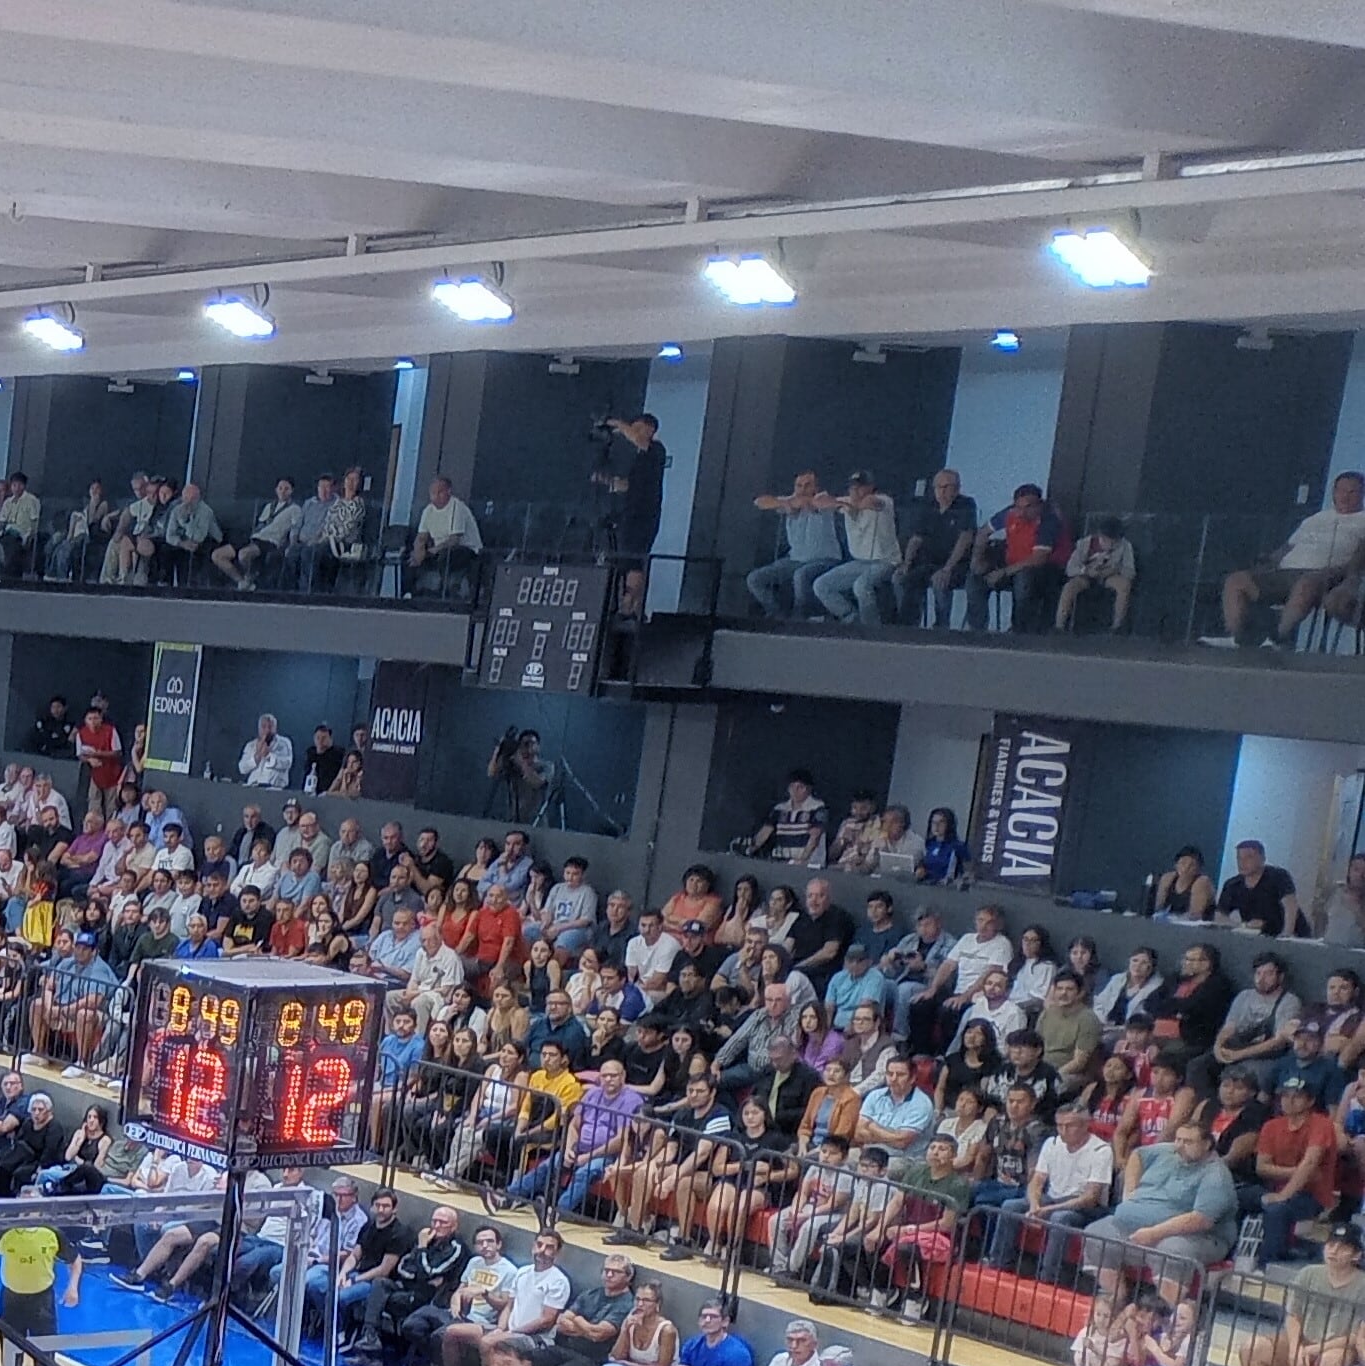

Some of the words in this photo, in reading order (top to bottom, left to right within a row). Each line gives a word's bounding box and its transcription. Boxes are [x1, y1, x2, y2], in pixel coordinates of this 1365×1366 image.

[371, 707, 421, 743] ACACIA
[991, 738, 1011, 806] FIAMBRES
[1000, 731, 1070, 876] ACACIA
[982, 821, 999, 864] VINOS
[170, 1050, 226, 1138] 12
[284, 1058, 352, 1142] 12
